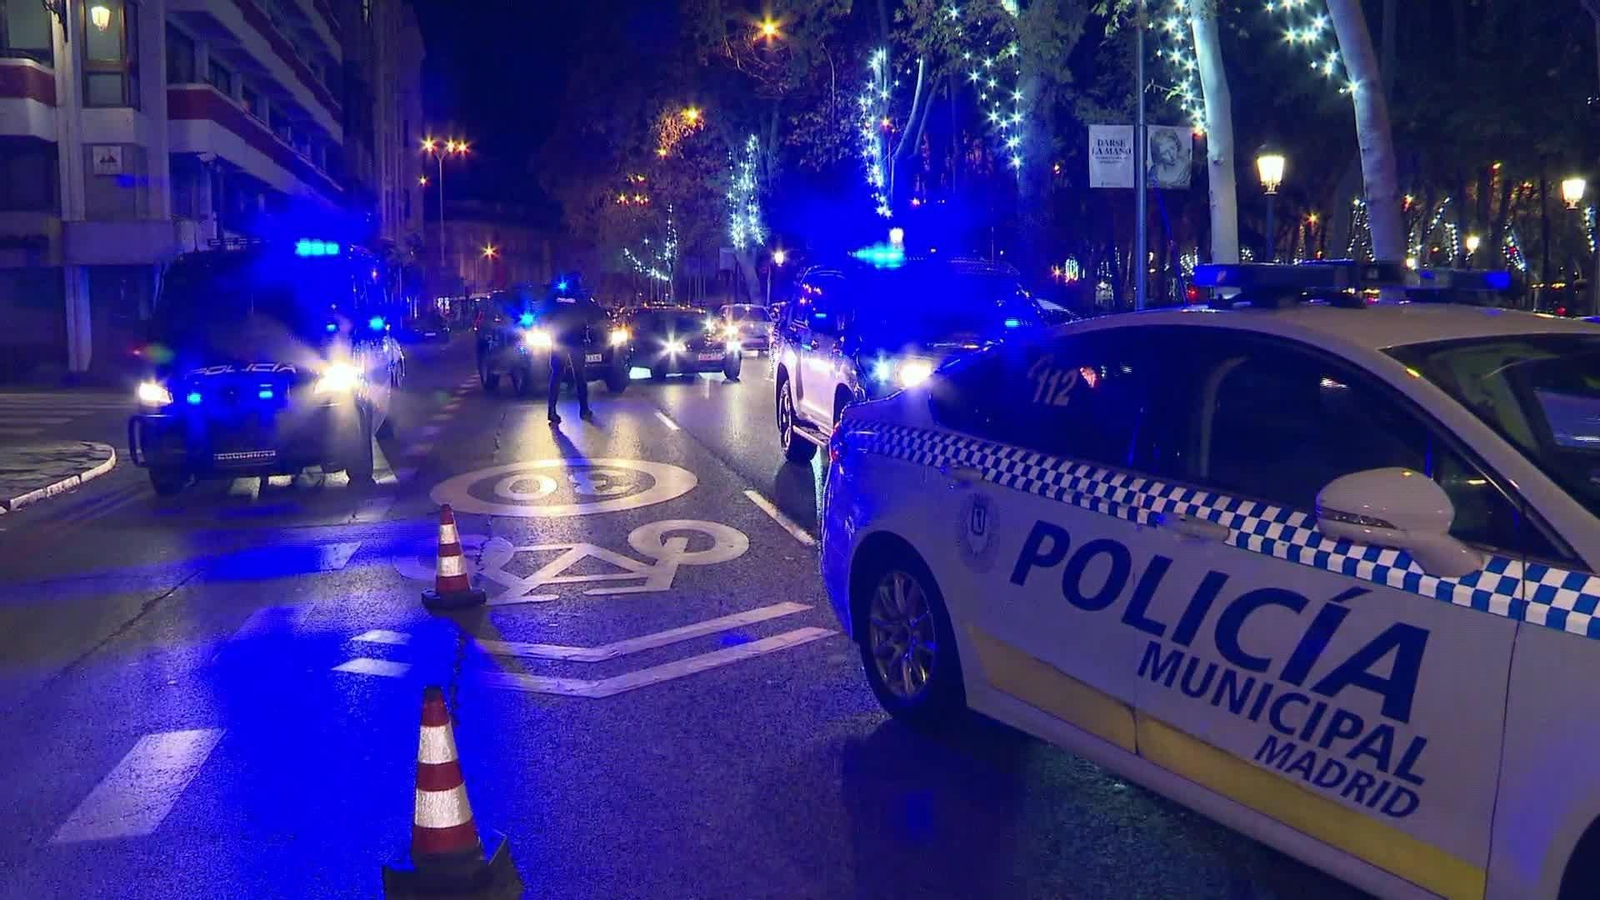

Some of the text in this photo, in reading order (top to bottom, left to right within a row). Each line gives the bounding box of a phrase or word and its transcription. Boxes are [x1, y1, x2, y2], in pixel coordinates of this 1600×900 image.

[1097, 139, 1126, 147] DARSE
[1105, 147, 1132, 155] MANO
[1033, 368, 1077, 406] 112
[1009, 519, 1431, 724] POLICÍA
[1137, 641, 1427, 786] MUNICIPAL
[1254, 735, 1420, 820] MADRID
